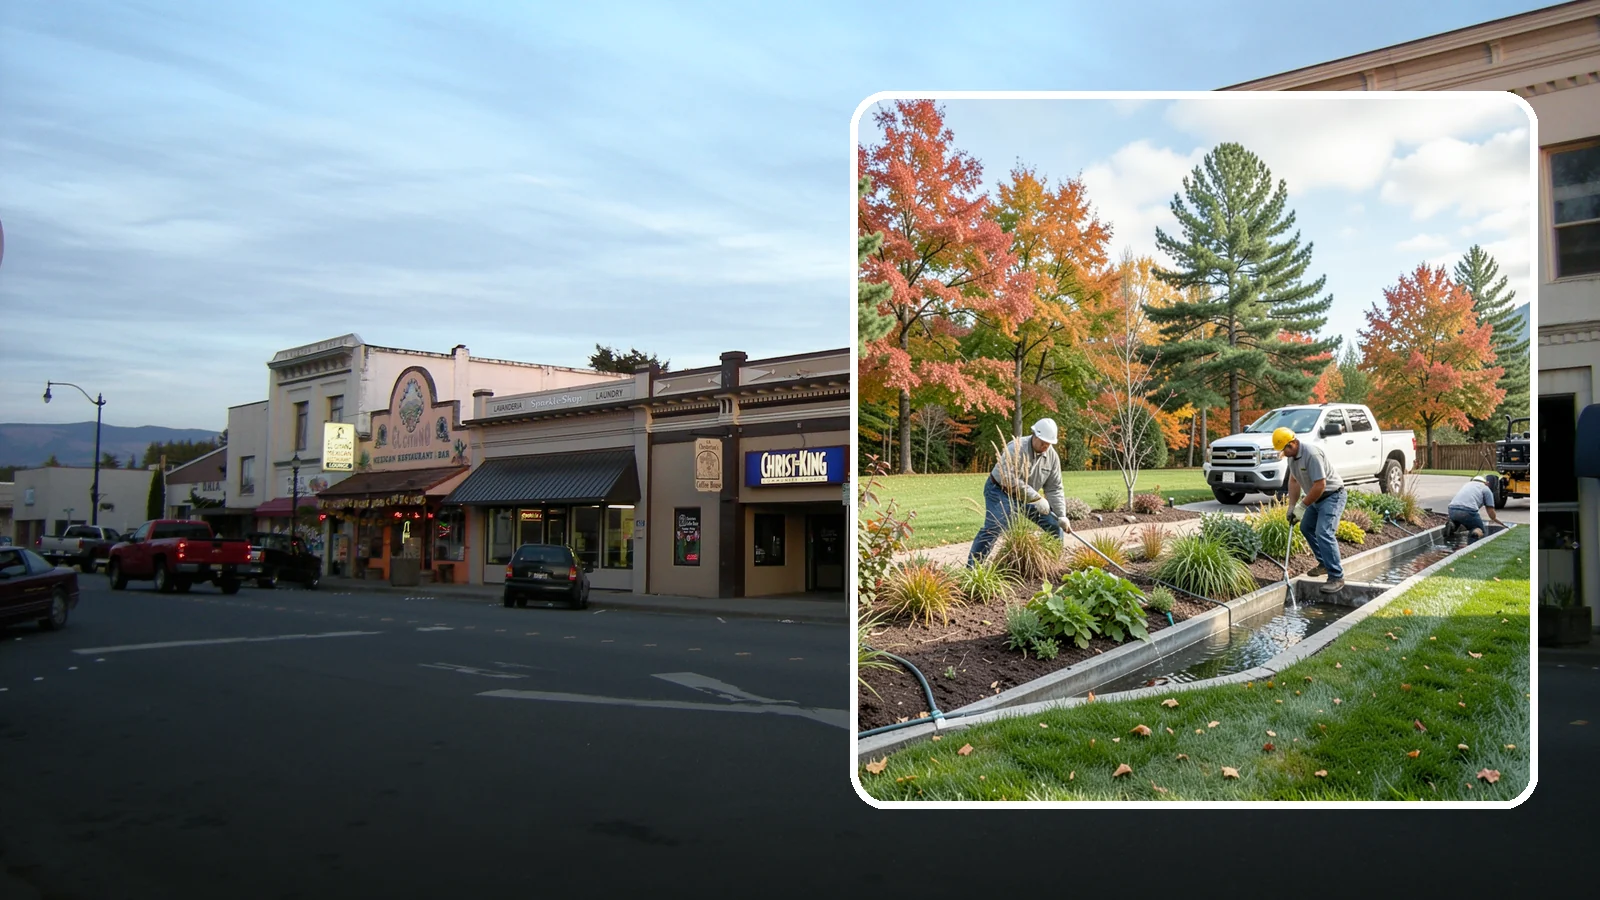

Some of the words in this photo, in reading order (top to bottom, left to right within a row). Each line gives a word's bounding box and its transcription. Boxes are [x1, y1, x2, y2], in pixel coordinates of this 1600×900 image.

[493, 402, 522, 412] LAVANDERIA
[562, 394, 582, 404] Shop
[595, 389, 623, 399] LAUNDRY
[392, 425, 402, 449] EL
[373, 455, 396, 464] MEXICAN
[397, 452, 433, 462] RESTAURANT
[437, 450, 450, 458] BAR
[761, 452, 797, 478] CHRIST
[799, 450, 827, 476] KING
